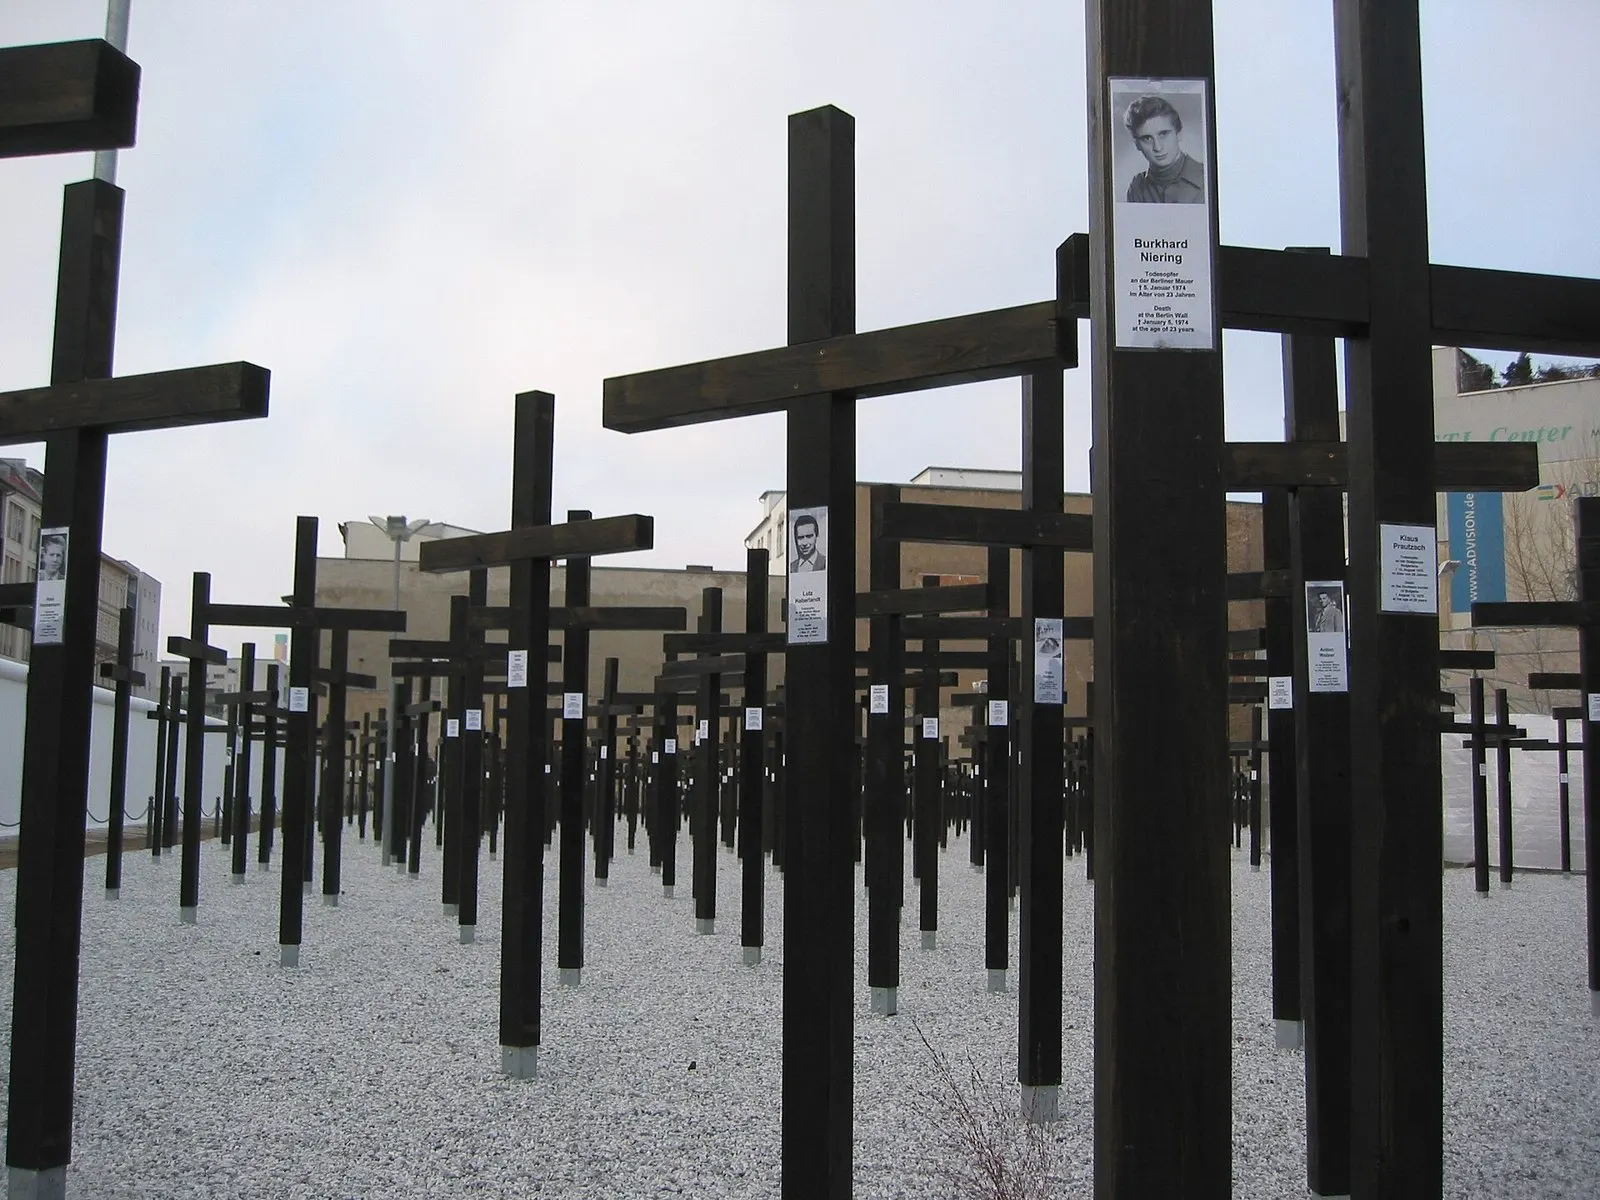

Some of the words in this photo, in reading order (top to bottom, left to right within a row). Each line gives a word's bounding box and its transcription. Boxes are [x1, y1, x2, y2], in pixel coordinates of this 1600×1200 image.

[1134, 239, 1188, 249] Burkhard
[1141, 252, 1182, 264] Niering
[1464, 493, 1477, 602] www.ADVISION.de
